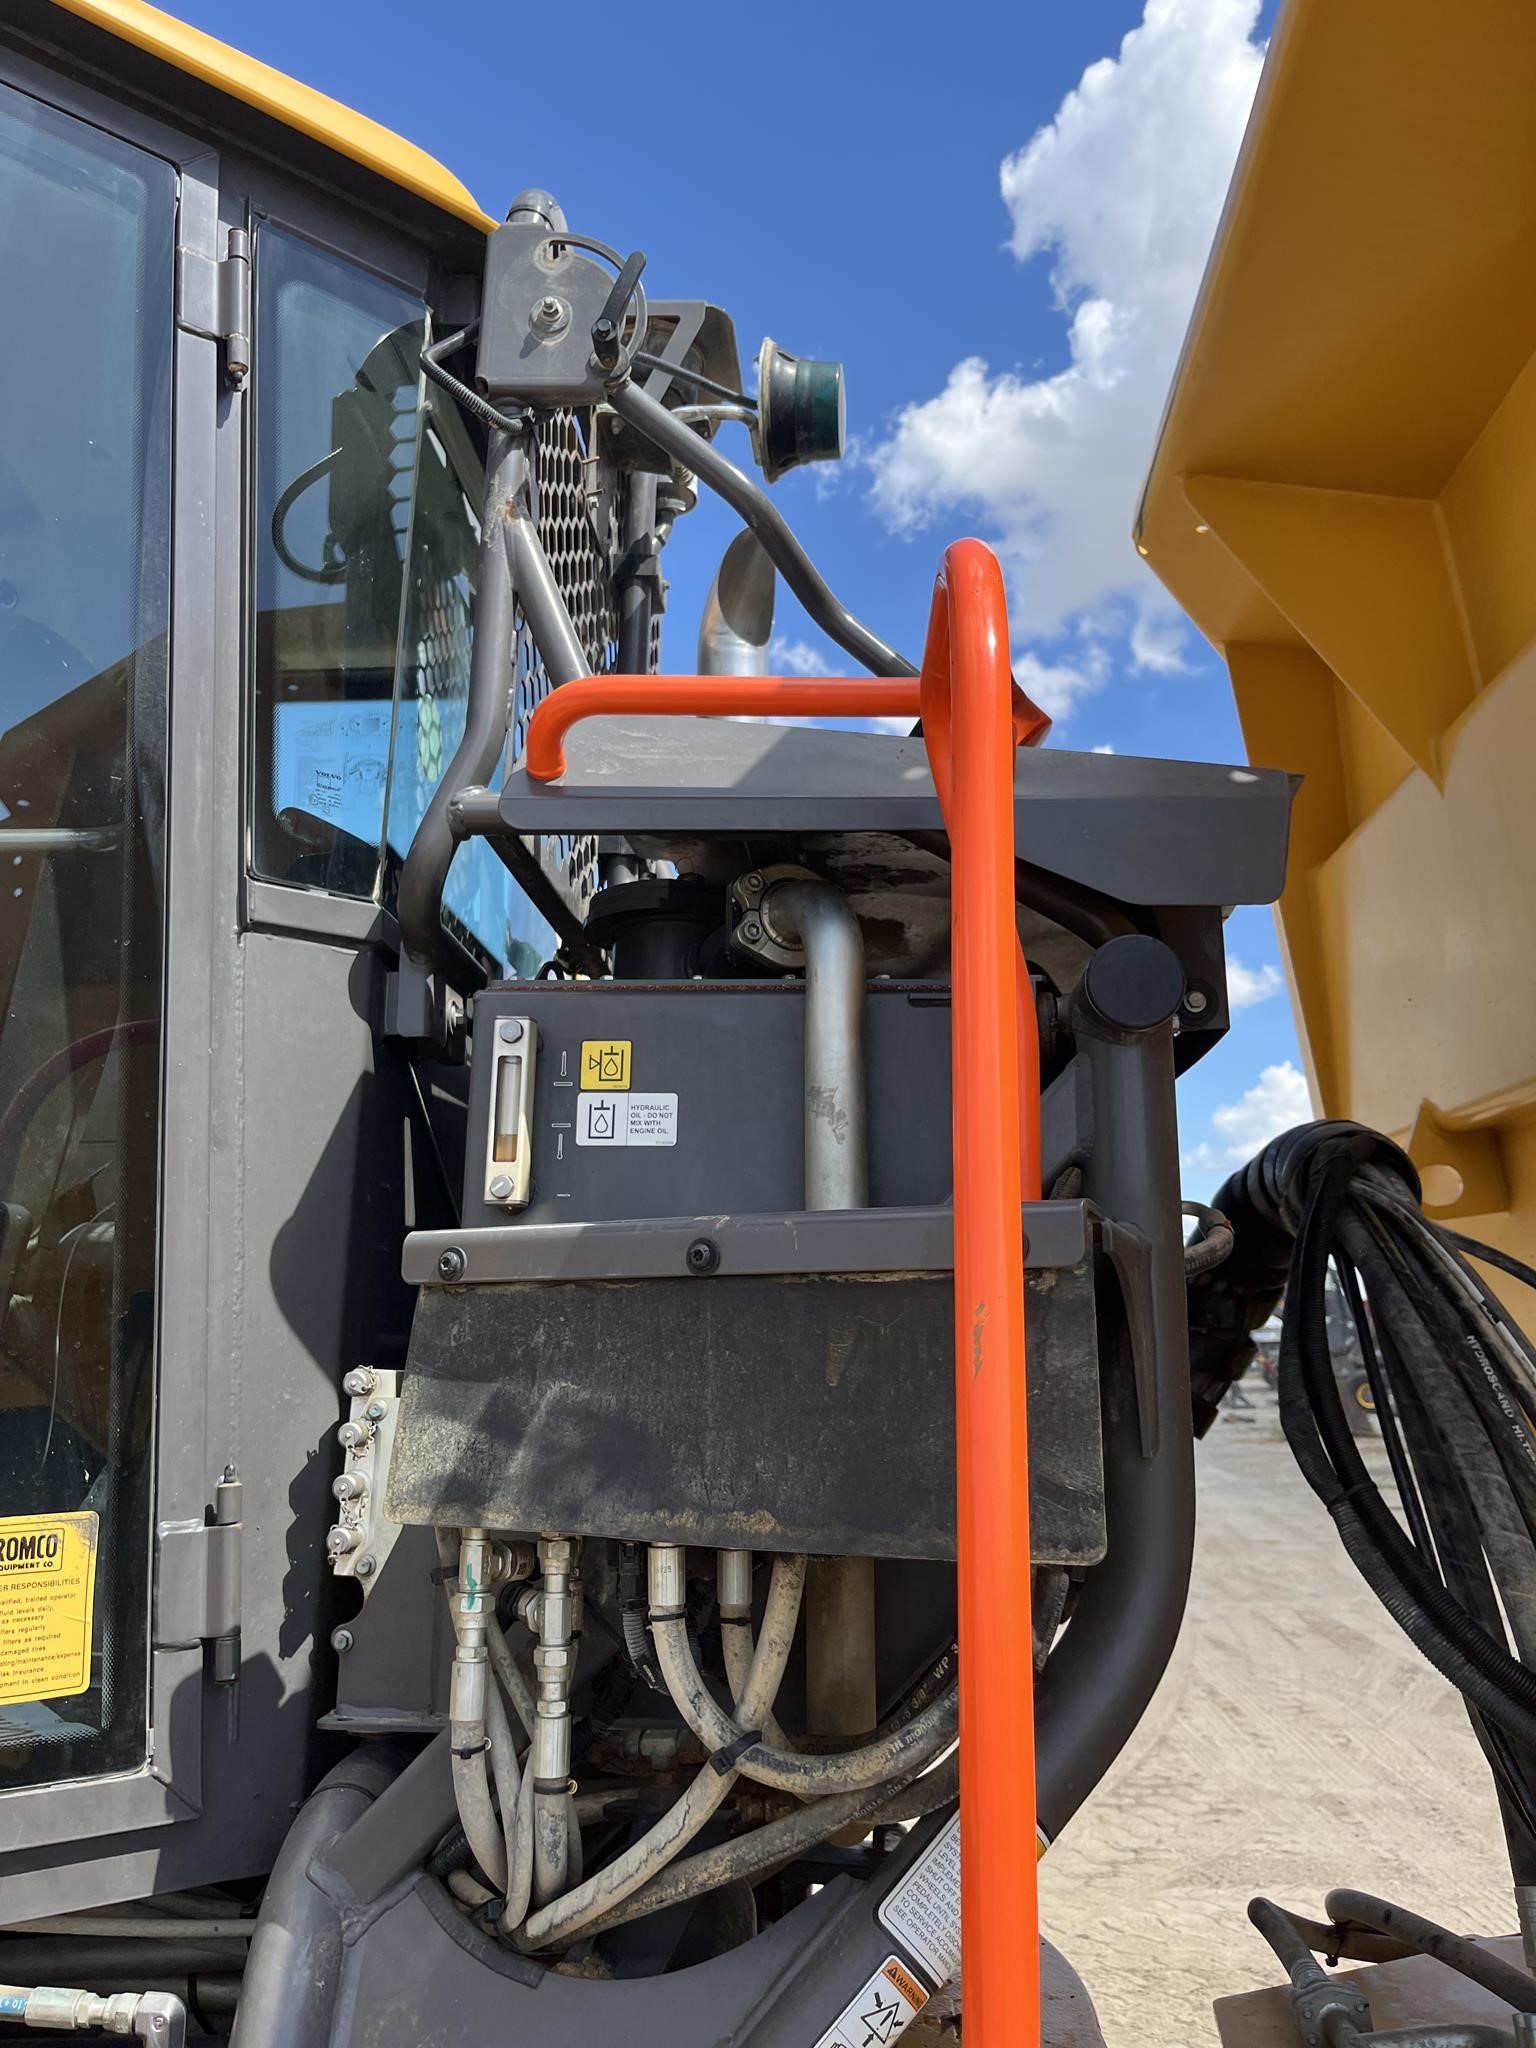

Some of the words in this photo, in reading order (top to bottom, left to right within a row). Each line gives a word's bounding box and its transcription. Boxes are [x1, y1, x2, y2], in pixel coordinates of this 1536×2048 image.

[316, 770, 341, 780] VOLVO
[1467, 1335, 1514, 1419] HYDROSCAND
[11, 1578, 80, 1591] RESPONSIBILITIES
[25, 1595, 47, 1603] trained
[50, 1592, 76, 1601] operator
[12, 1615, 44, 1624] necessary
[17, 1607, 35, 1615] levels
[18, 1625, 46, 1634] regularly
[35, 1633, 61, 1642] required
[13, 1667, 44, 1676] insurance
[51, 1672, 81, 1681] condition
[933, 1656, 949, 1679] WP
[938, 1849, 956, 1871] LEVEL
[925, 1865, 943, 1885] SHUT
[943, 1883, 958, 1898] OFF
[932, 1857, 960, 1889] IMPLEME
[913, 1881, 933, 1905] PEDAL
[933, 1902, 951, 1924] UNTIL
[920, 1873, 947, 1903] WHEELS
[945, 1900, 960, 1917] AND
[900, 1896, 911, 1909] TO
[909, 1906, 938, 1938] SERVICE
[907, 1889, 947, 1934] COMPLETELY
[893, 1905, 907, 1920] SEE
[906, 1918, 940, 1957] OPERATOR
